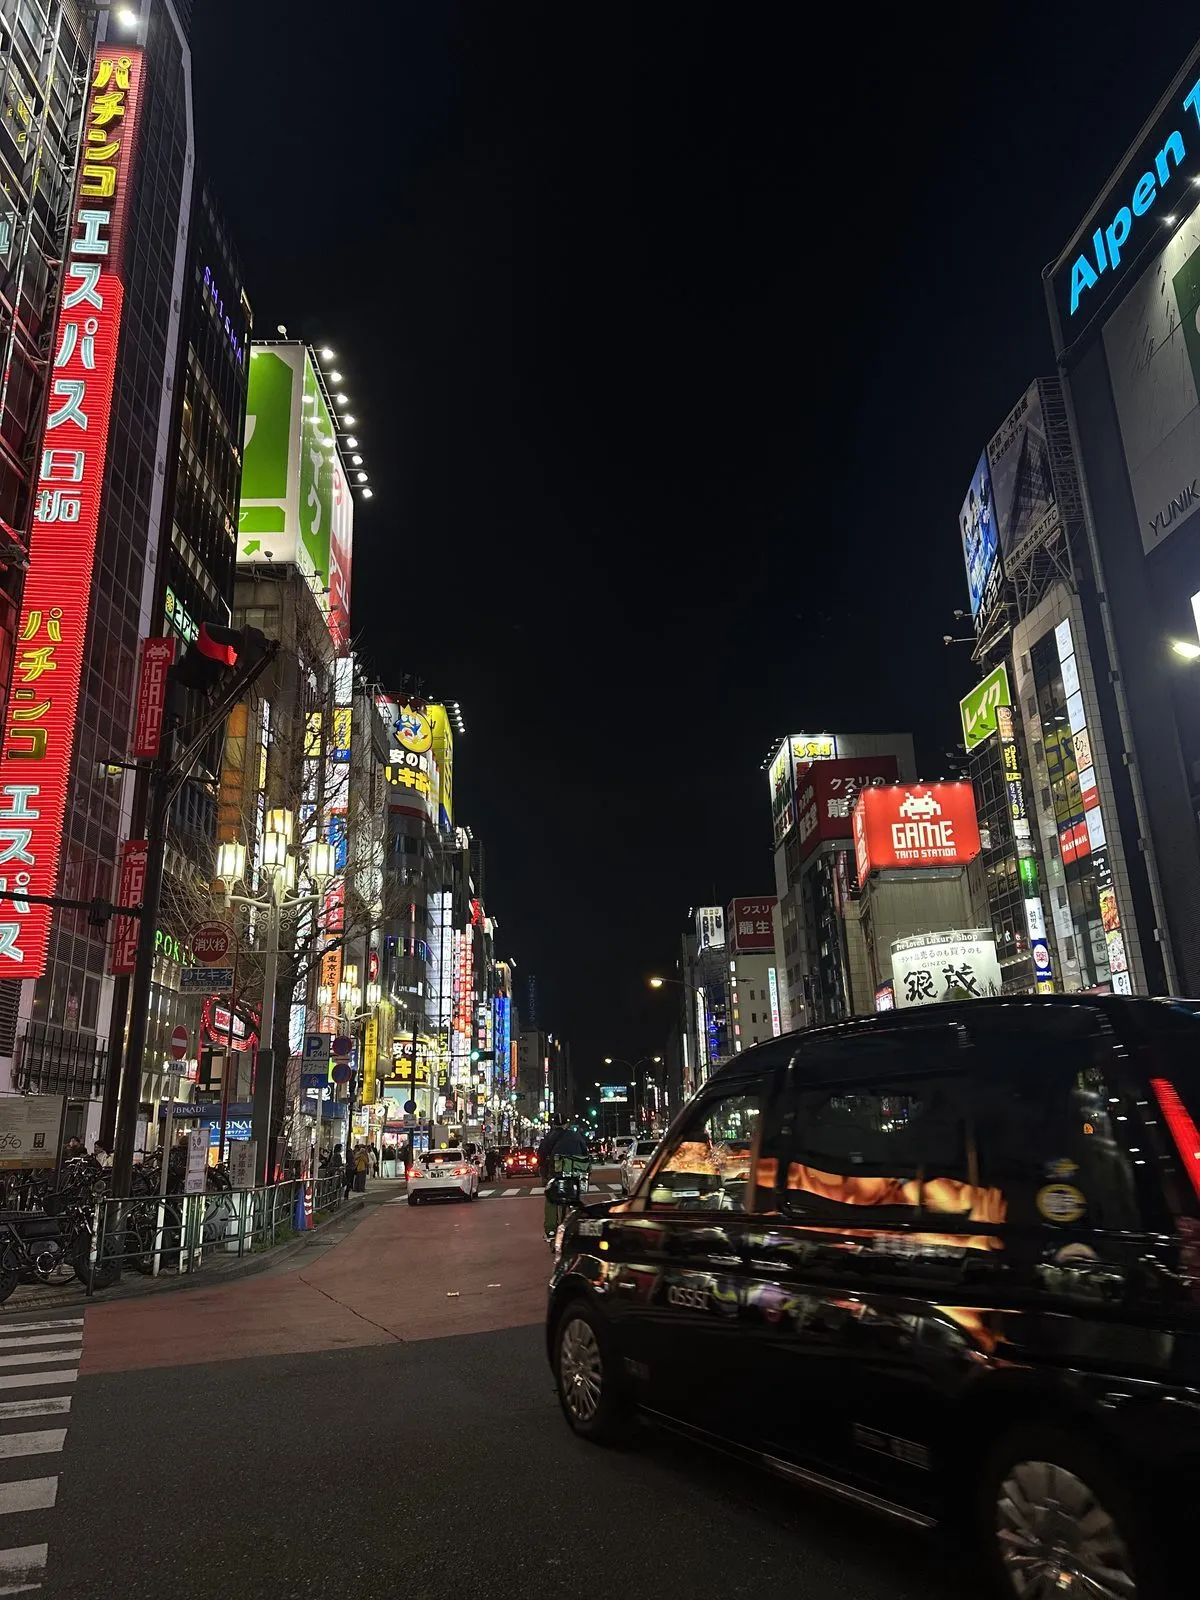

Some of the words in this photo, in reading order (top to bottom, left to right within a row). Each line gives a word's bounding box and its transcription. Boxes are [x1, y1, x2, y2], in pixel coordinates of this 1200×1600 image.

[81, 56, 131, 198] パチンコ
[1070, 130, 1186, 315] Alpen
[203, 266, 242, 364] SHISHA
[7, 607, 63, 760] パチンコ
[965, 681, 1001, 733] レイク
[830, 775, 886, 791] クスリの
[891, 820, 956, 849] GAME
[895, 850, 920, 860] TAITO
[921, 847, 958, 858] STATION
[742, 904, 774, 915] クスリ
[738, 920, 774, 936] 龍生
[194, 937, 226, 952] 消火栓
[926, 935, 955, 946] Luxury
[956, 933, 979, 942] Shop
[921, 960, 947, 968] GINZO
[305, 1036, 323, 1058] P
[317, 1050, 333, 1058] 24H
